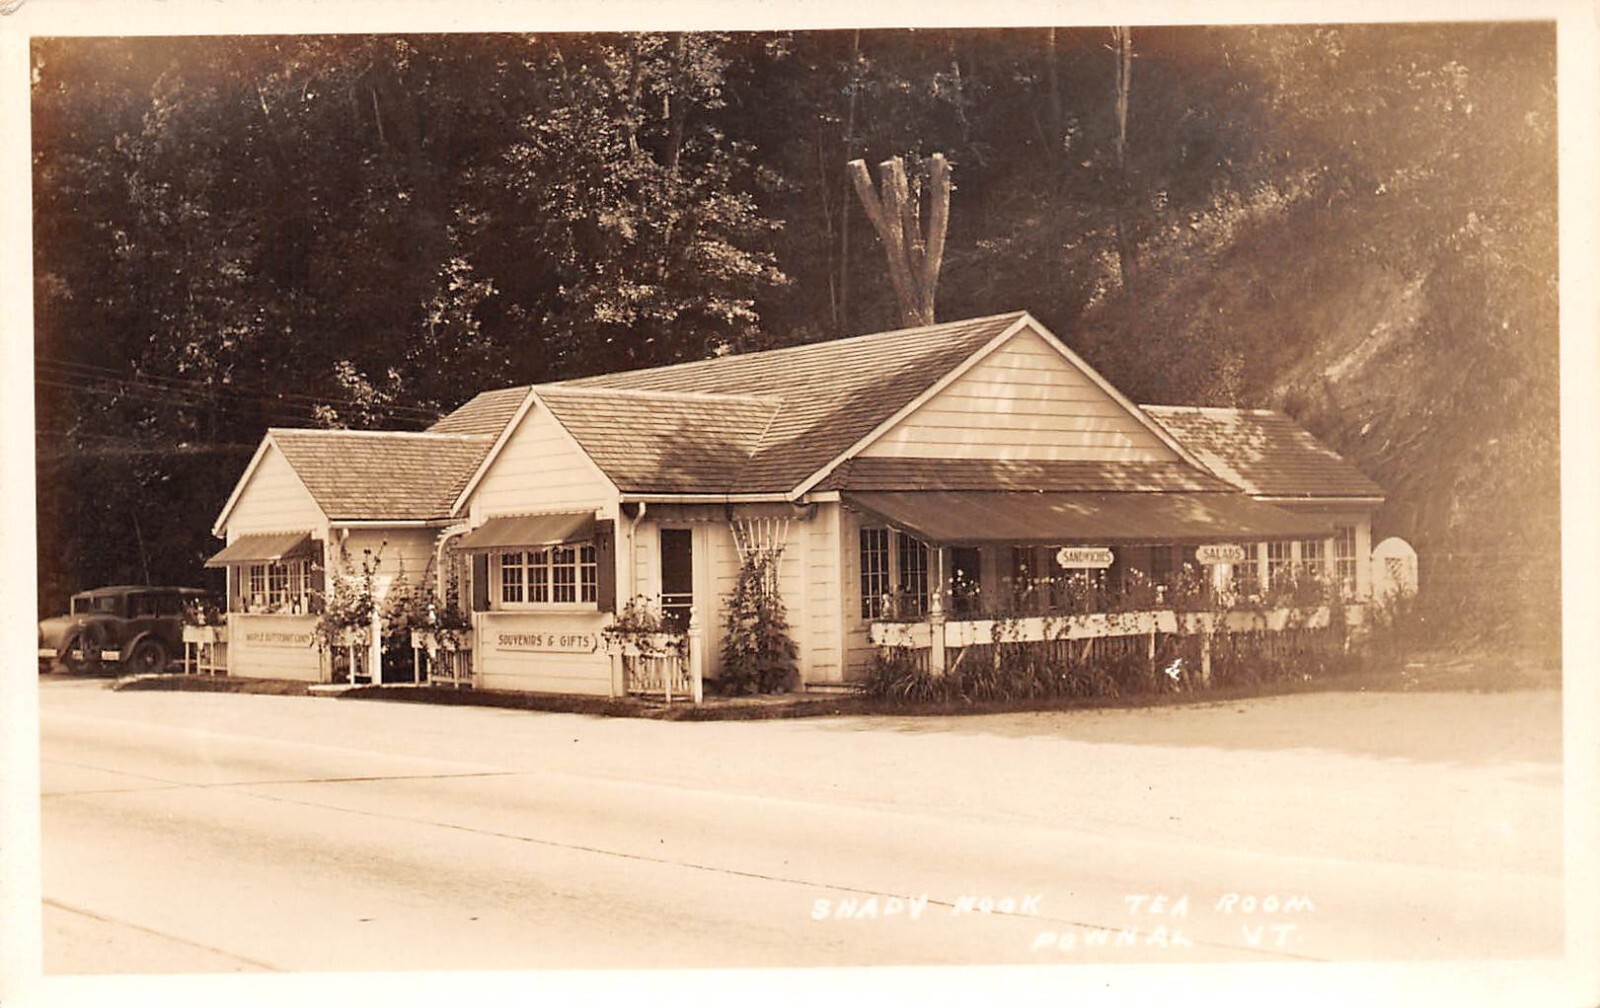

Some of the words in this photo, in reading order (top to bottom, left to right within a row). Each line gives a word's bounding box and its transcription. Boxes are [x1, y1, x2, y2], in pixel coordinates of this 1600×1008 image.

[1063, 550, 1111, 563] SANDWICHES
[1203, 547, 1241, 559] SALADS
[498, 634, 542, 647] SOUVENIRS
[547, 635, 554, 647] &
[560, 635, 590, 648] GIFTS
